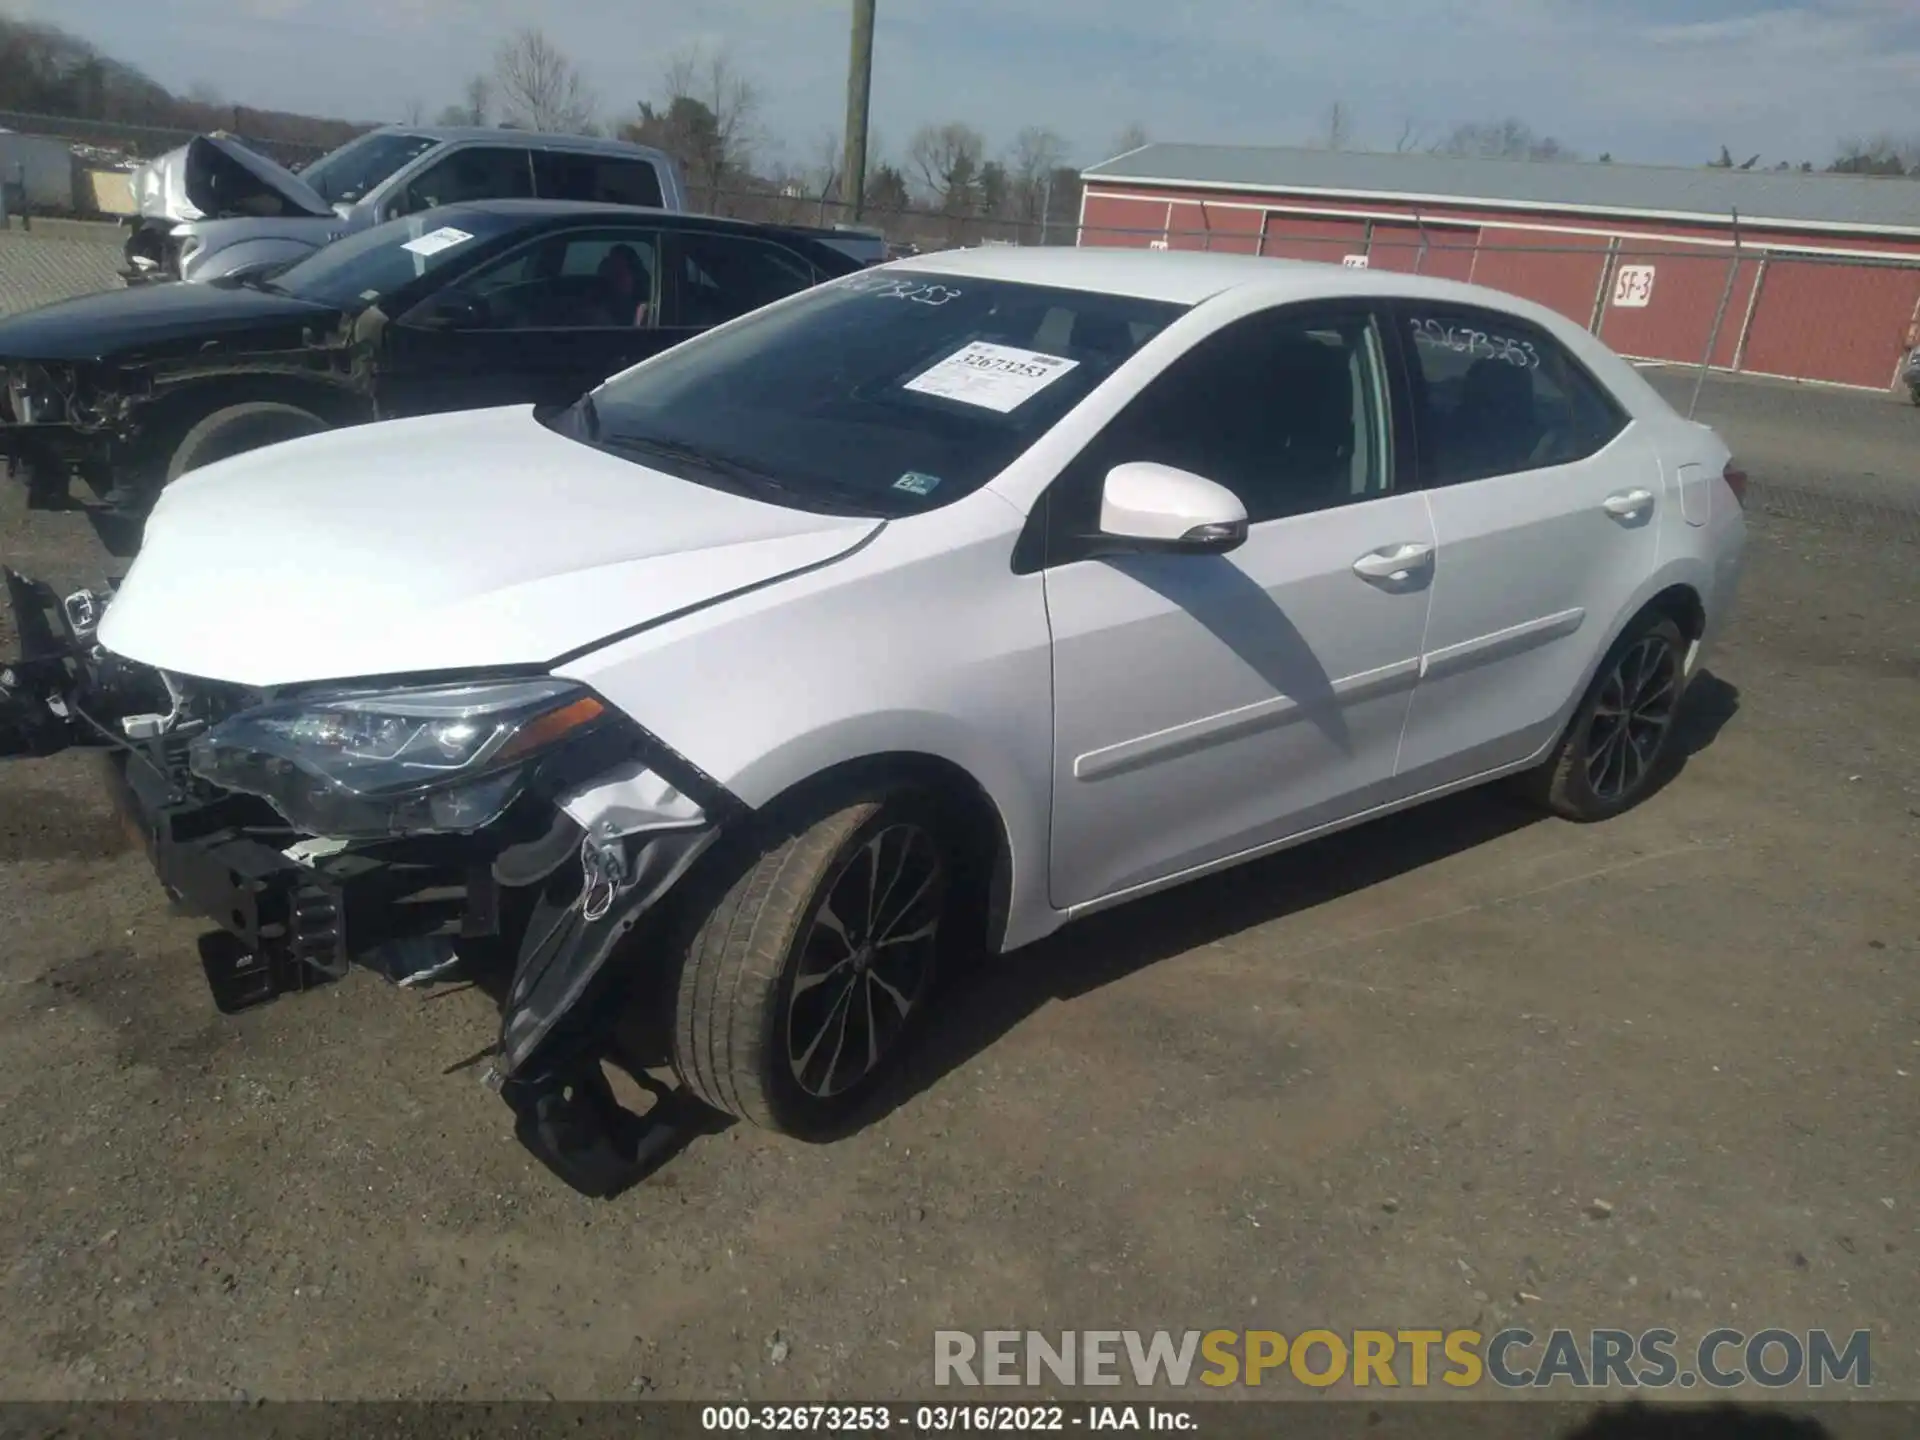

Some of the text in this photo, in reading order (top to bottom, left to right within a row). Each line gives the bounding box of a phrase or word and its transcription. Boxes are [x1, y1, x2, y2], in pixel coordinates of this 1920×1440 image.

[1617, 271, 1651, 300] SF-3
[1410, 318, 1540, 369] 32673253
[963, 353, 1048, 377] 32673253
